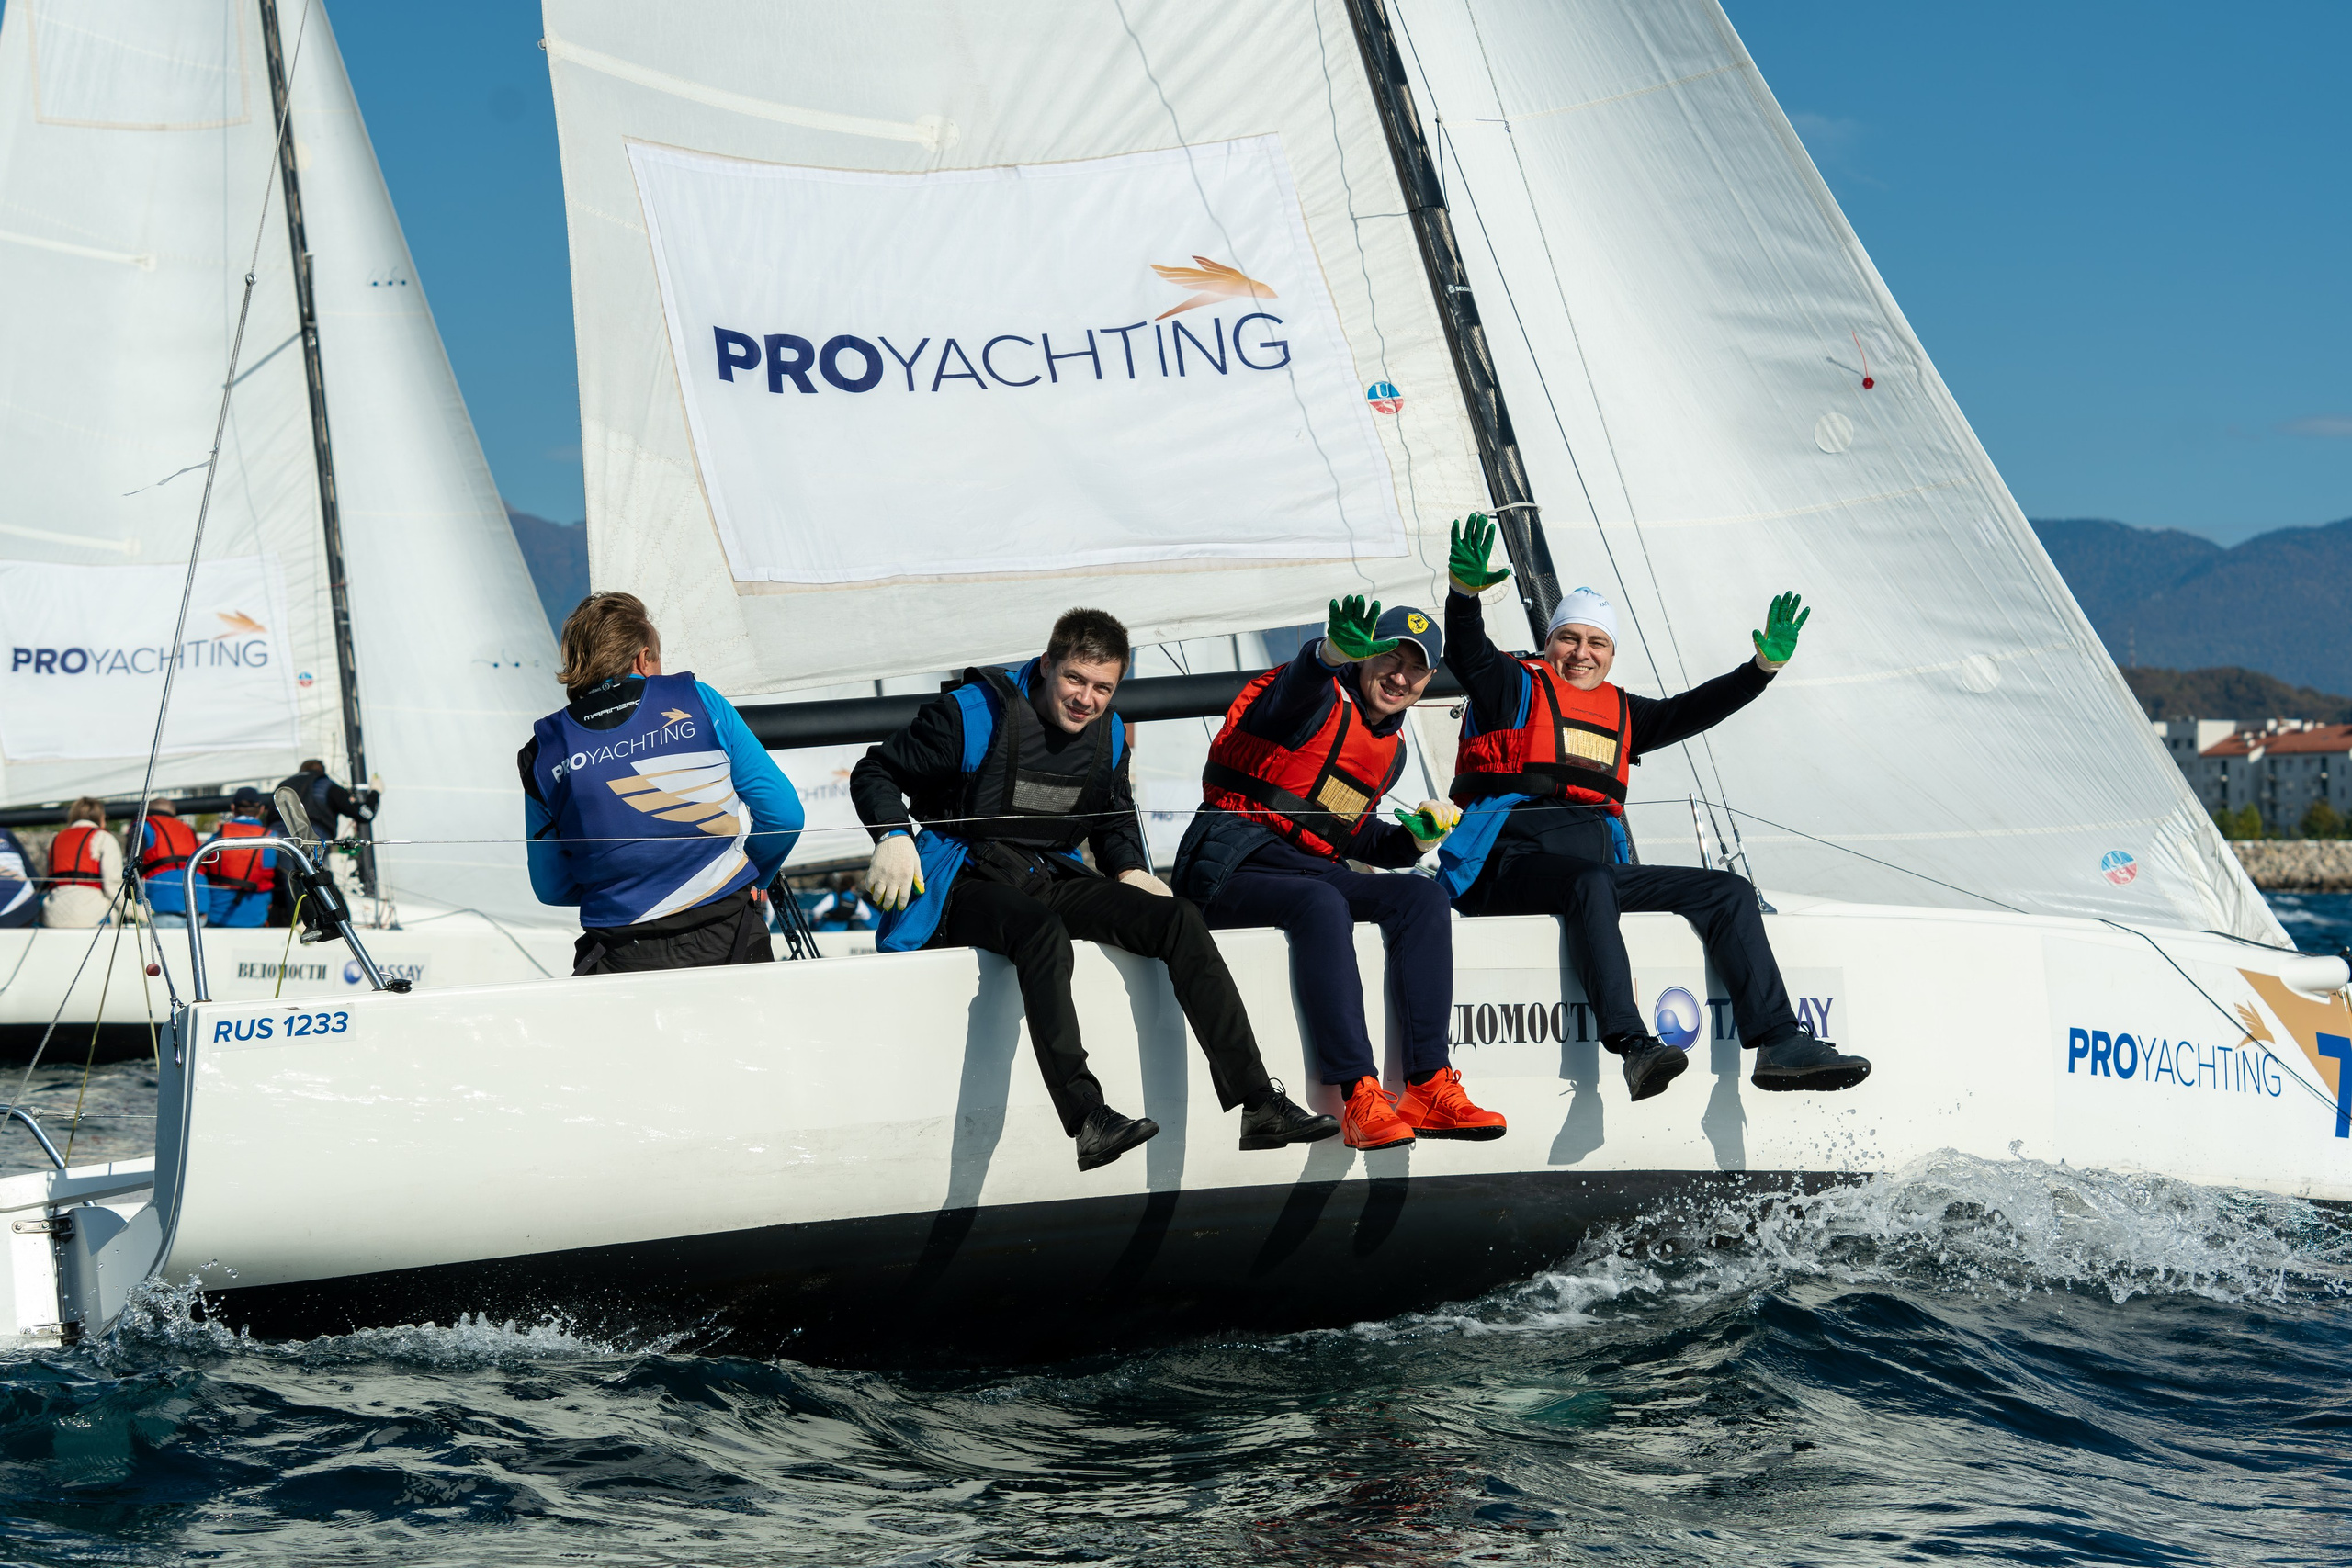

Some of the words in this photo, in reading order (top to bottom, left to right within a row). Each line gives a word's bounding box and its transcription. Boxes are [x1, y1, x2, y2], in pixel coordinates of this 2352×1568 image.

[712, 312, 1292, 394] PROYACHTING
[11, 639, 269, 675] PROYACHTING
[583, 698, 640, 721] MARINEPO
[551, 721, 695, 784] PROYACHTING
[238, 962, 327, 980] ВЕДОМОСТИ
[377, 964, 424, 982] ASSAY
[213, 1018, 274, 1043] RUS
[283, 1011, 349, 1037] 1233
[1448, 1001, 1601, 1054] ДОМОСТ
[1705, 998, 1834, 1040] TAY
[2068, 1027, 2281, 1097] PROYACHTING
